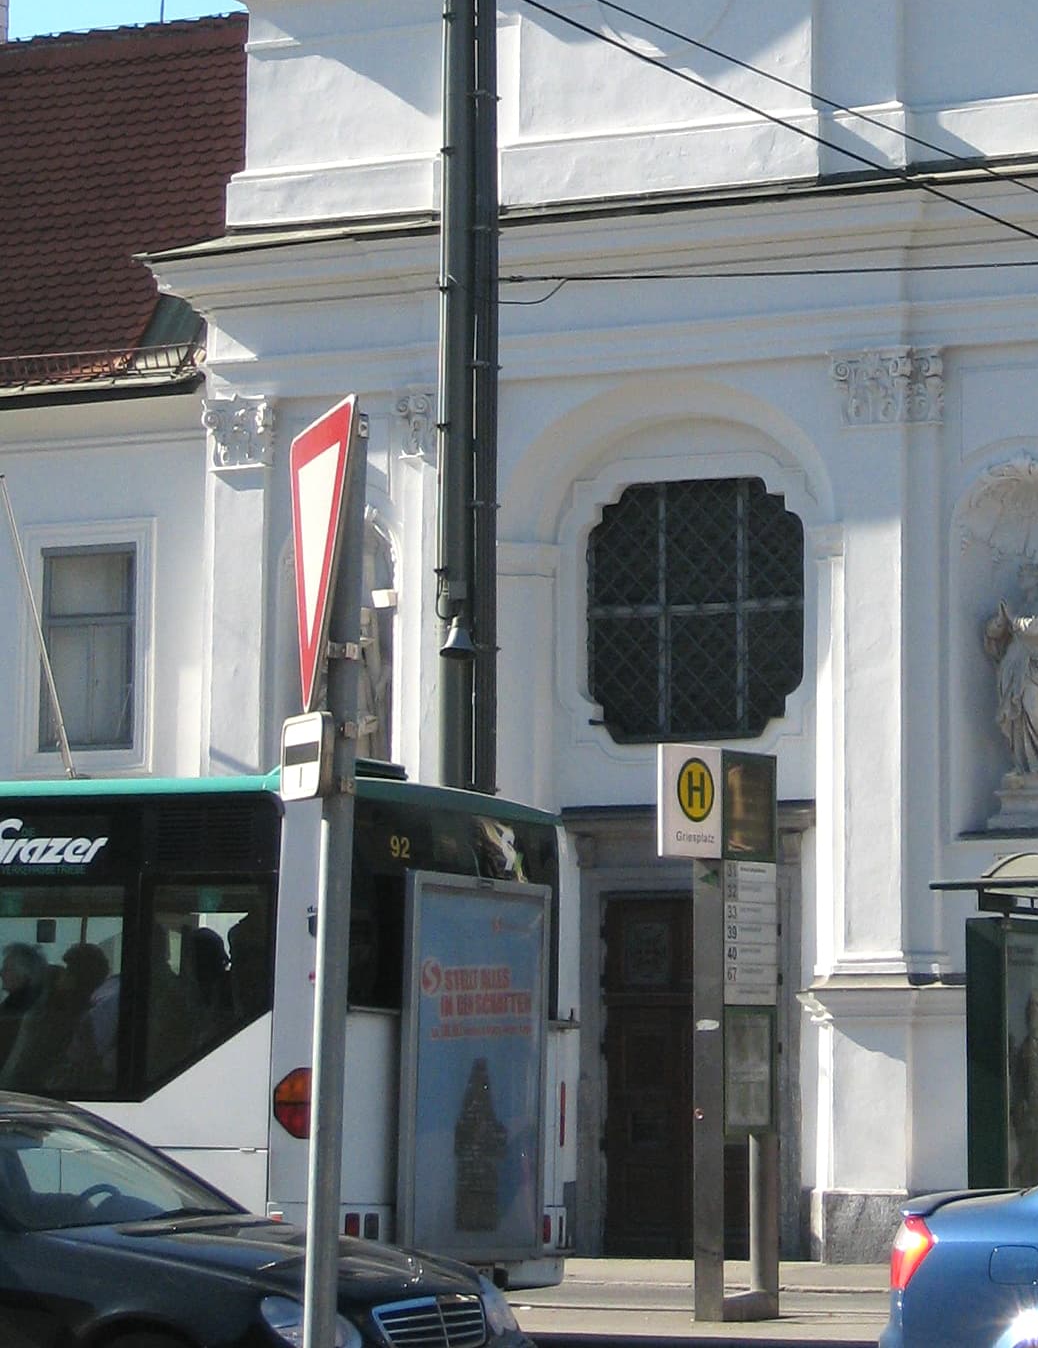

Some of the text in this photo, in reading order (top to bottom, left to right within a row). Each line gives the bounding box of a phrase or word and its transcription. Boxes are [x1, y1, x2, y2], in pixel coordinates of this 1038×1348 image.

[687, 771, 705, 809] H
[0, 818, 109, 864] Grazer
[676, 830, 715, 844] Griesplatz
[390, 835, 411, 859] 92
[727, 883, 737, 898] 32
[727, 904, 737, 919] 33
[727, 925, 738, 940] 39
[727, 946, 738, 961] 40
[727, 966, 737, 982] 67
